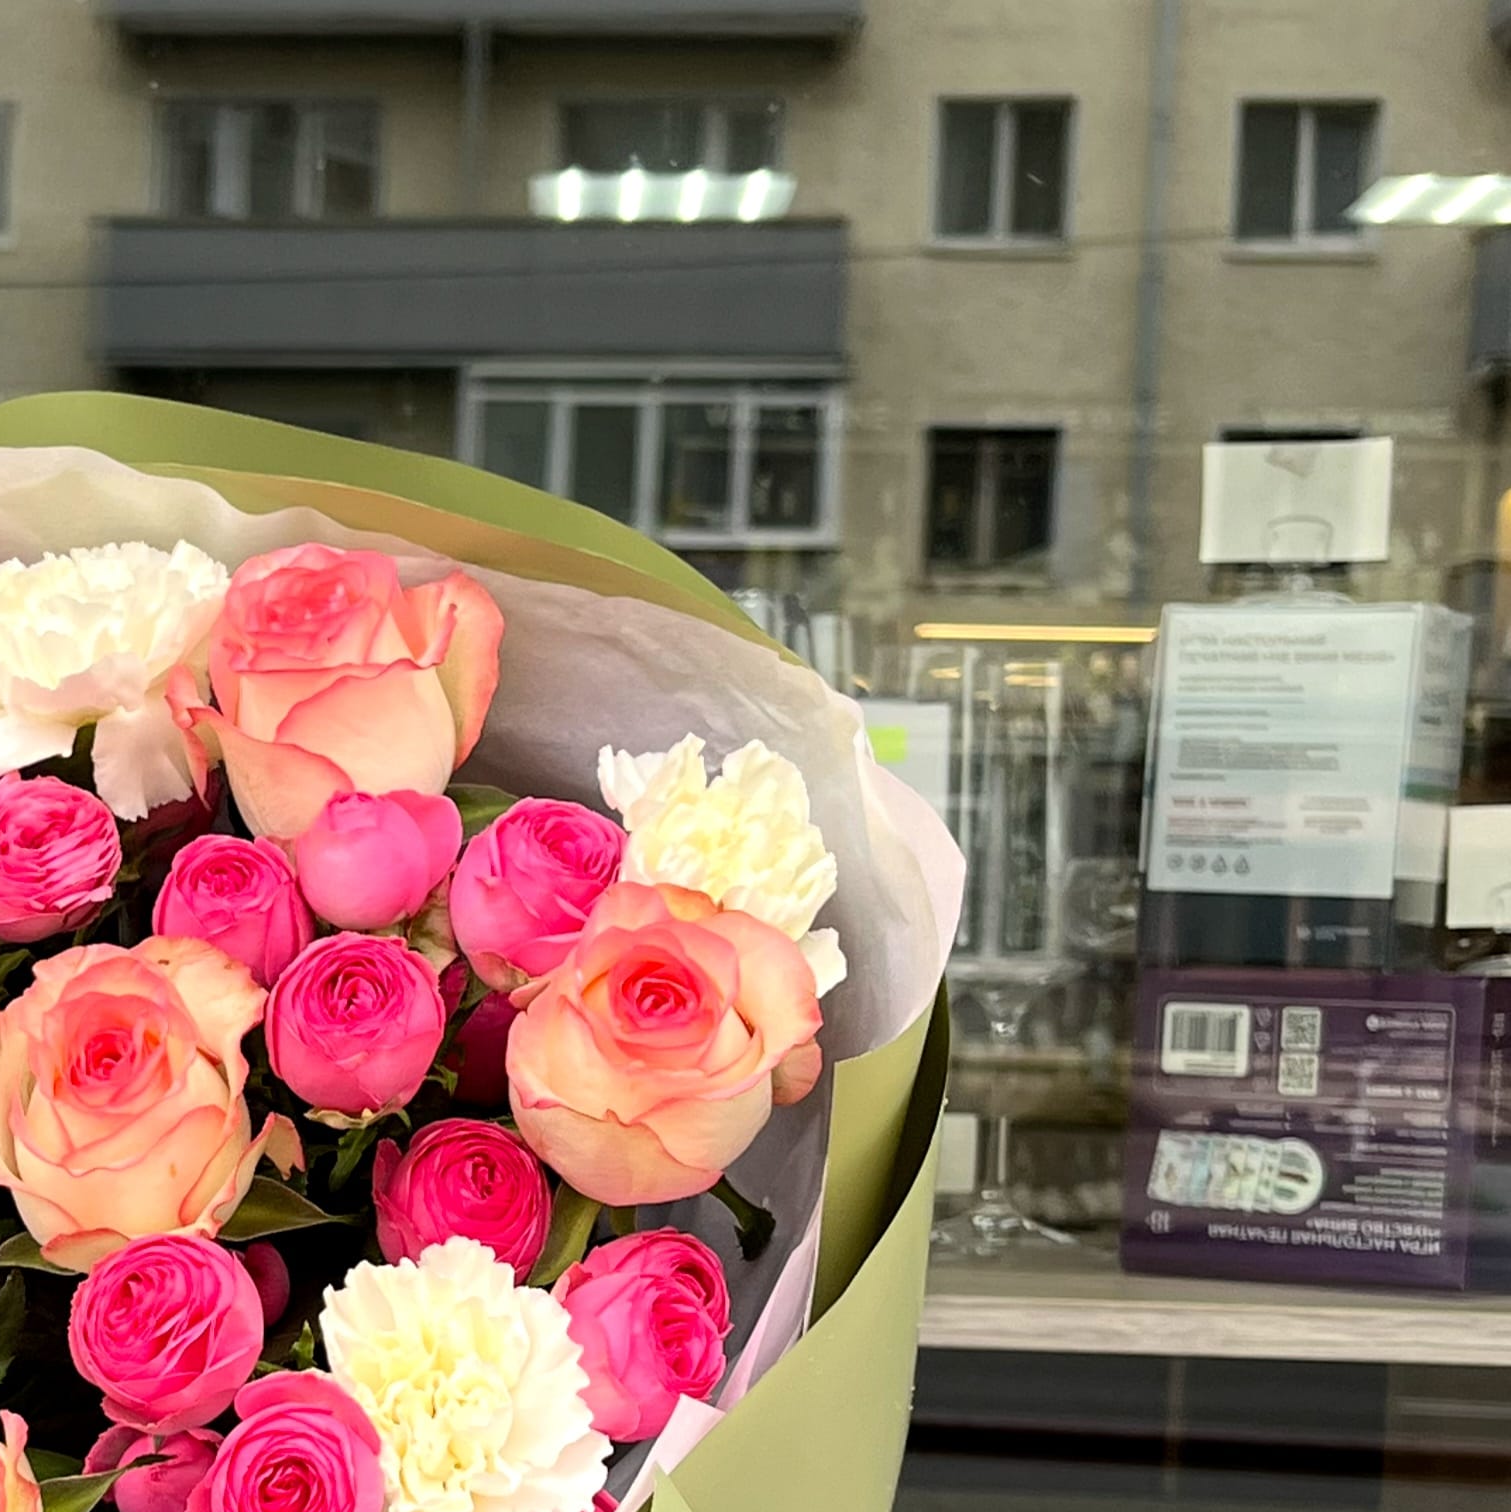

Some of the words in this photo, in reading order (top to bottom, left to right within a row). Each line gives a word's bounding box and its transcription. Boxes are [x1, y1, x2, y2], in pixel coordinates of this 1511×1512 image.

[1208, 1223, 1287, 1244] ПЕЧАТНАЯ
[1291, 1229, 1396, 1252] НАСТОЛЬНАЯ
[1399, 1238, 1441, 1256] ИГРА
